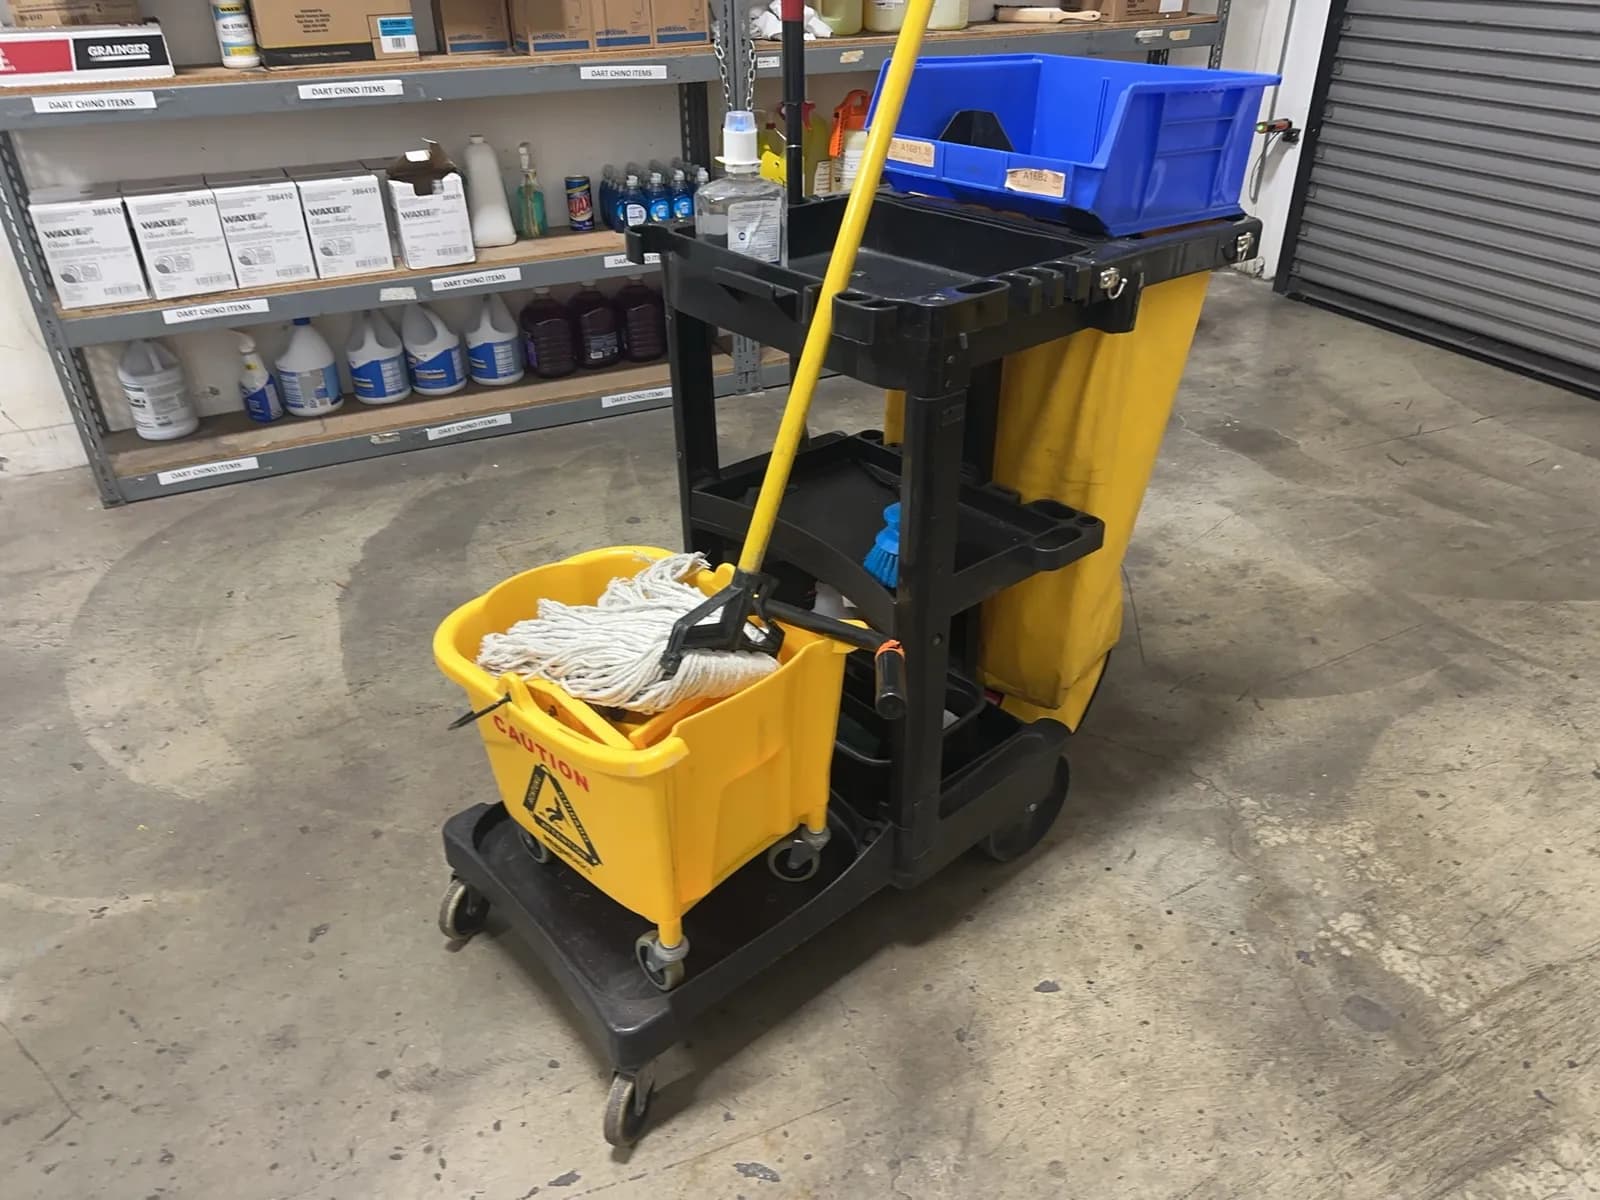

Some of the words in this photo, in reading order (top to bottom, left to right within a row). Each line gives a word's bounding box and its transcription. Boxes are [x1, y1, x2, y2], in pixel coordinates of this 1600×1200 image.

[87, 43, 150, 57] GRAINGER
[312, 87, 334, 95] DART
[335, 86, 360, 95] CHINO
[361, 85, 385, 93] ITEMS
[48, 101, 73, 109] DART
[75, 99, 106, 108] CHINO
[107, 98, 136, 106] ITEMS
[308, 206, 343, 216] WAXIE
[401, 209, 431, 219] WAXIE
[223, 213, 257, 223] WAXIE
[140, 219, 178, 229] WAXIE
[44, 228, 83, 238] WAXIE
[463, 276, 485, 284] CHINO
[486, 273, 506, 281] ITEMS
[176, 309, 198, 318] DART
[199, 306, 224, 315] CHINO
[225, 303, 252, 311] ITEMS
[492, 715, 590, 792] CAUTION
